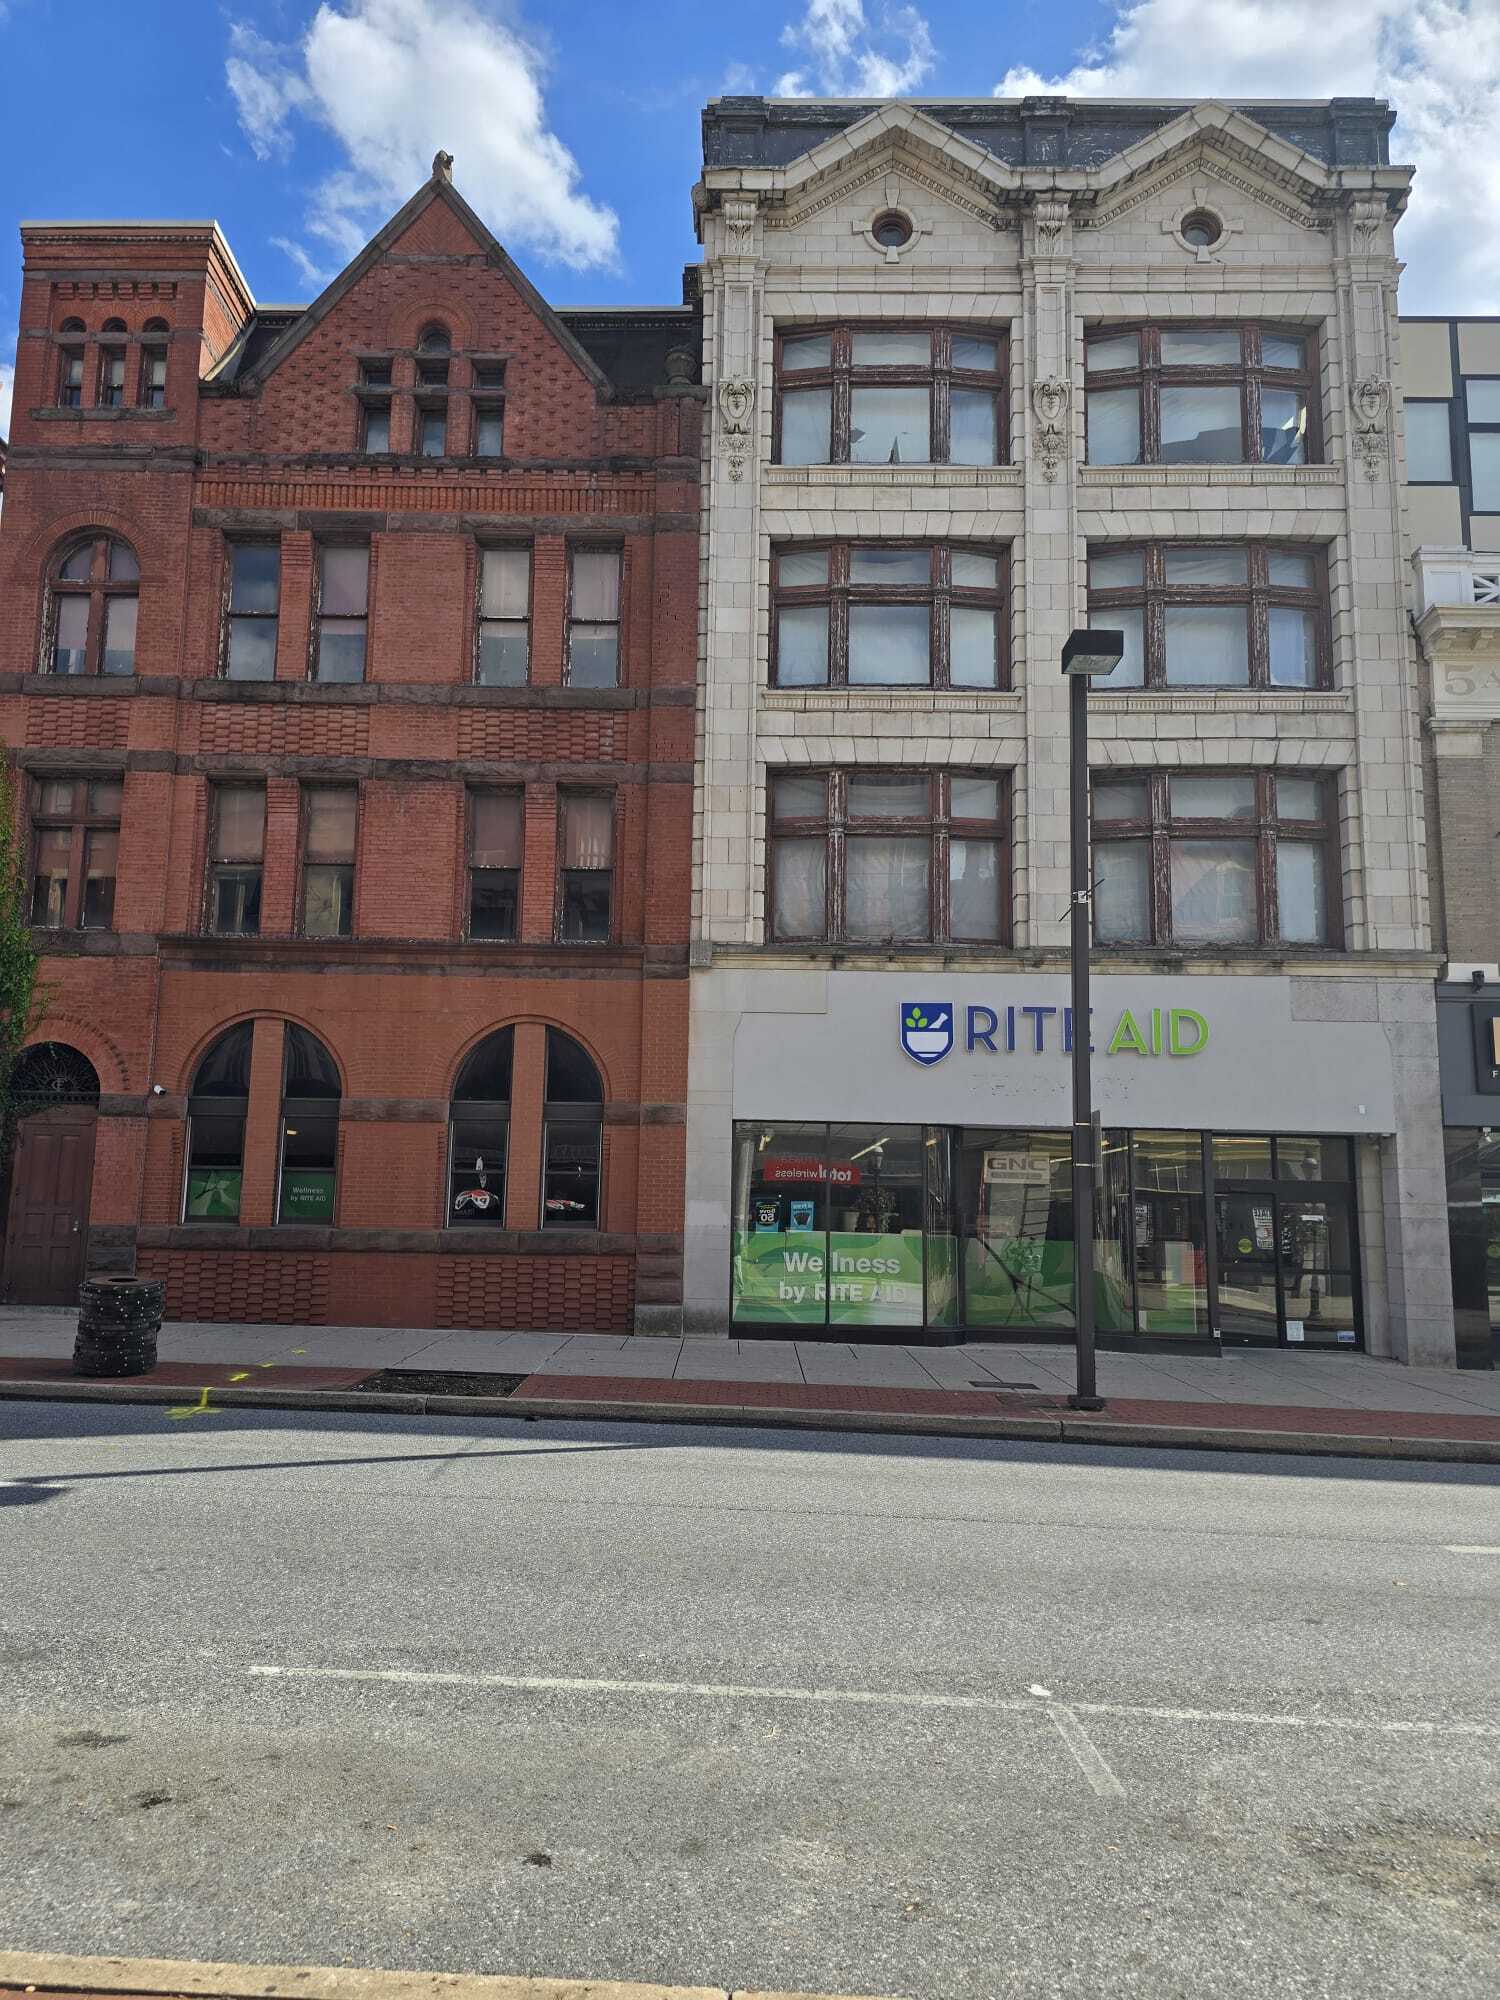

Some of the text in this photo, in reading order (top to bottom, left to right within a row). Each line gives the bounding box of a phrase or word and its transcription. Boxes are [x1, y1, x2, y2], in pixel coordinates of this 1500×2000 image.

[1107, 1007, 1210, 1056] AID
[988, 1157, 1047, 1170] GNC
[778, 1280, 806, 1304] by
